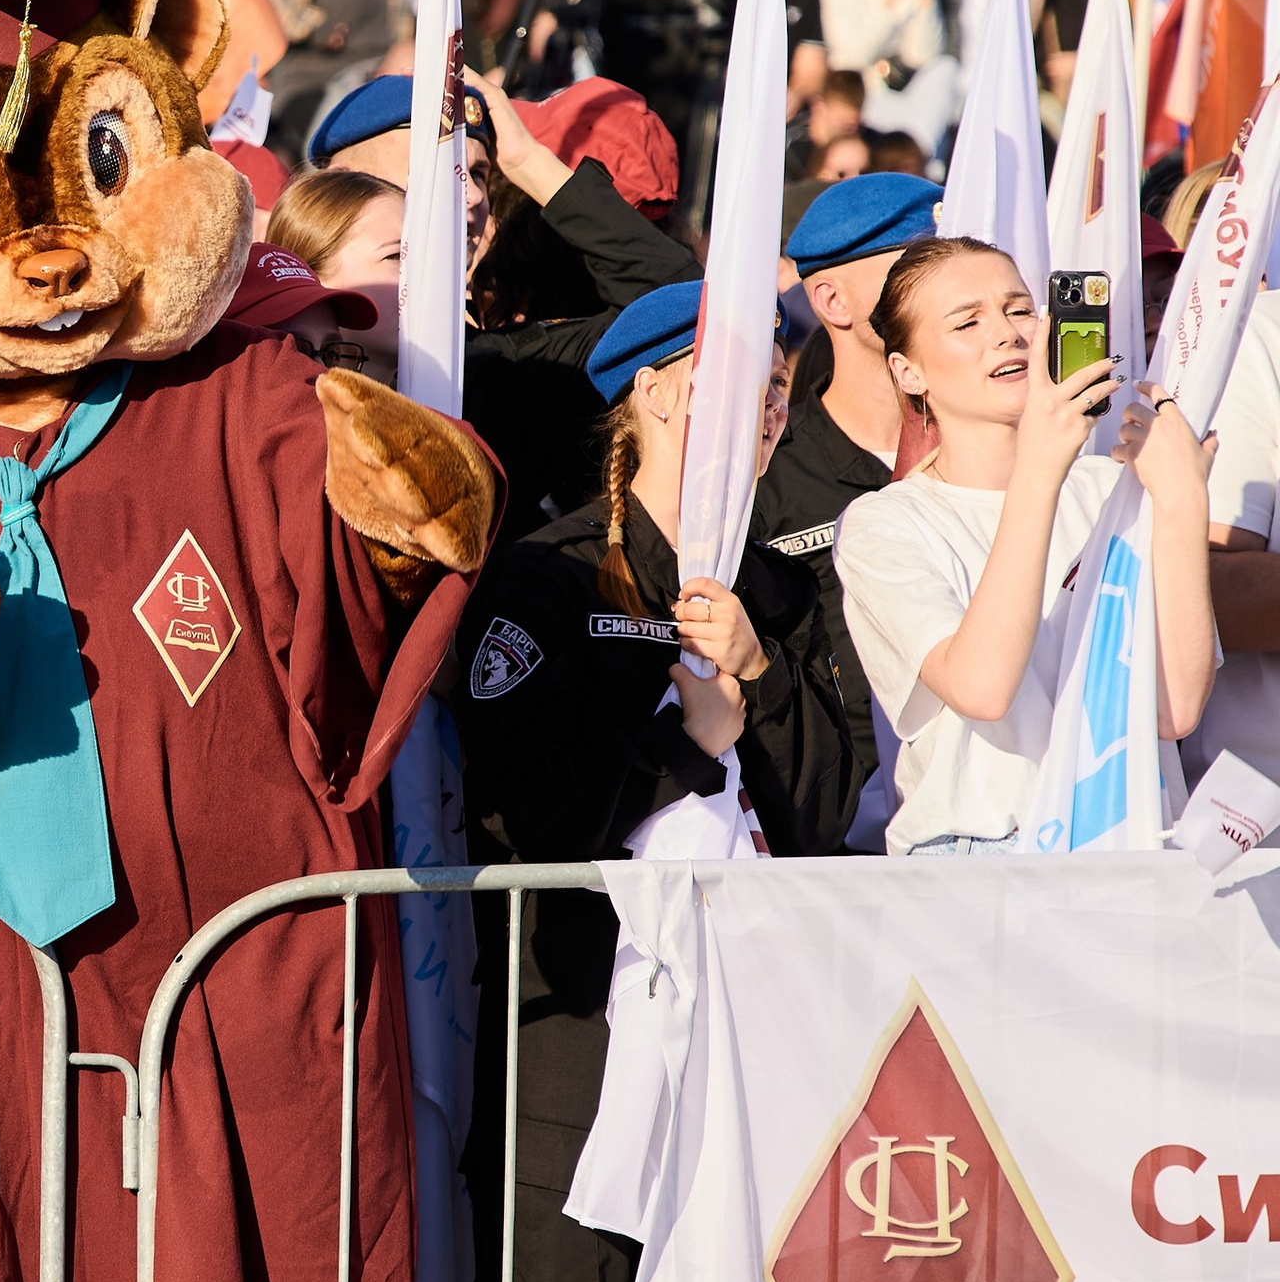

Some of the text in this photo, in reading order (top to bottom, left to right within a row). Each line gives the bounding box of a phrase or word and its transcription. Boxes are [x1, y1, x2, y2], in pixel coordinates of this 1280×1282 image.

[175, 628, 211, 642] СибУПК
[500, 624, 534, 654] БАРС
[597, 618, 674, 640] СИБУПК
[1130, 1143, 1280, 1246] Си
